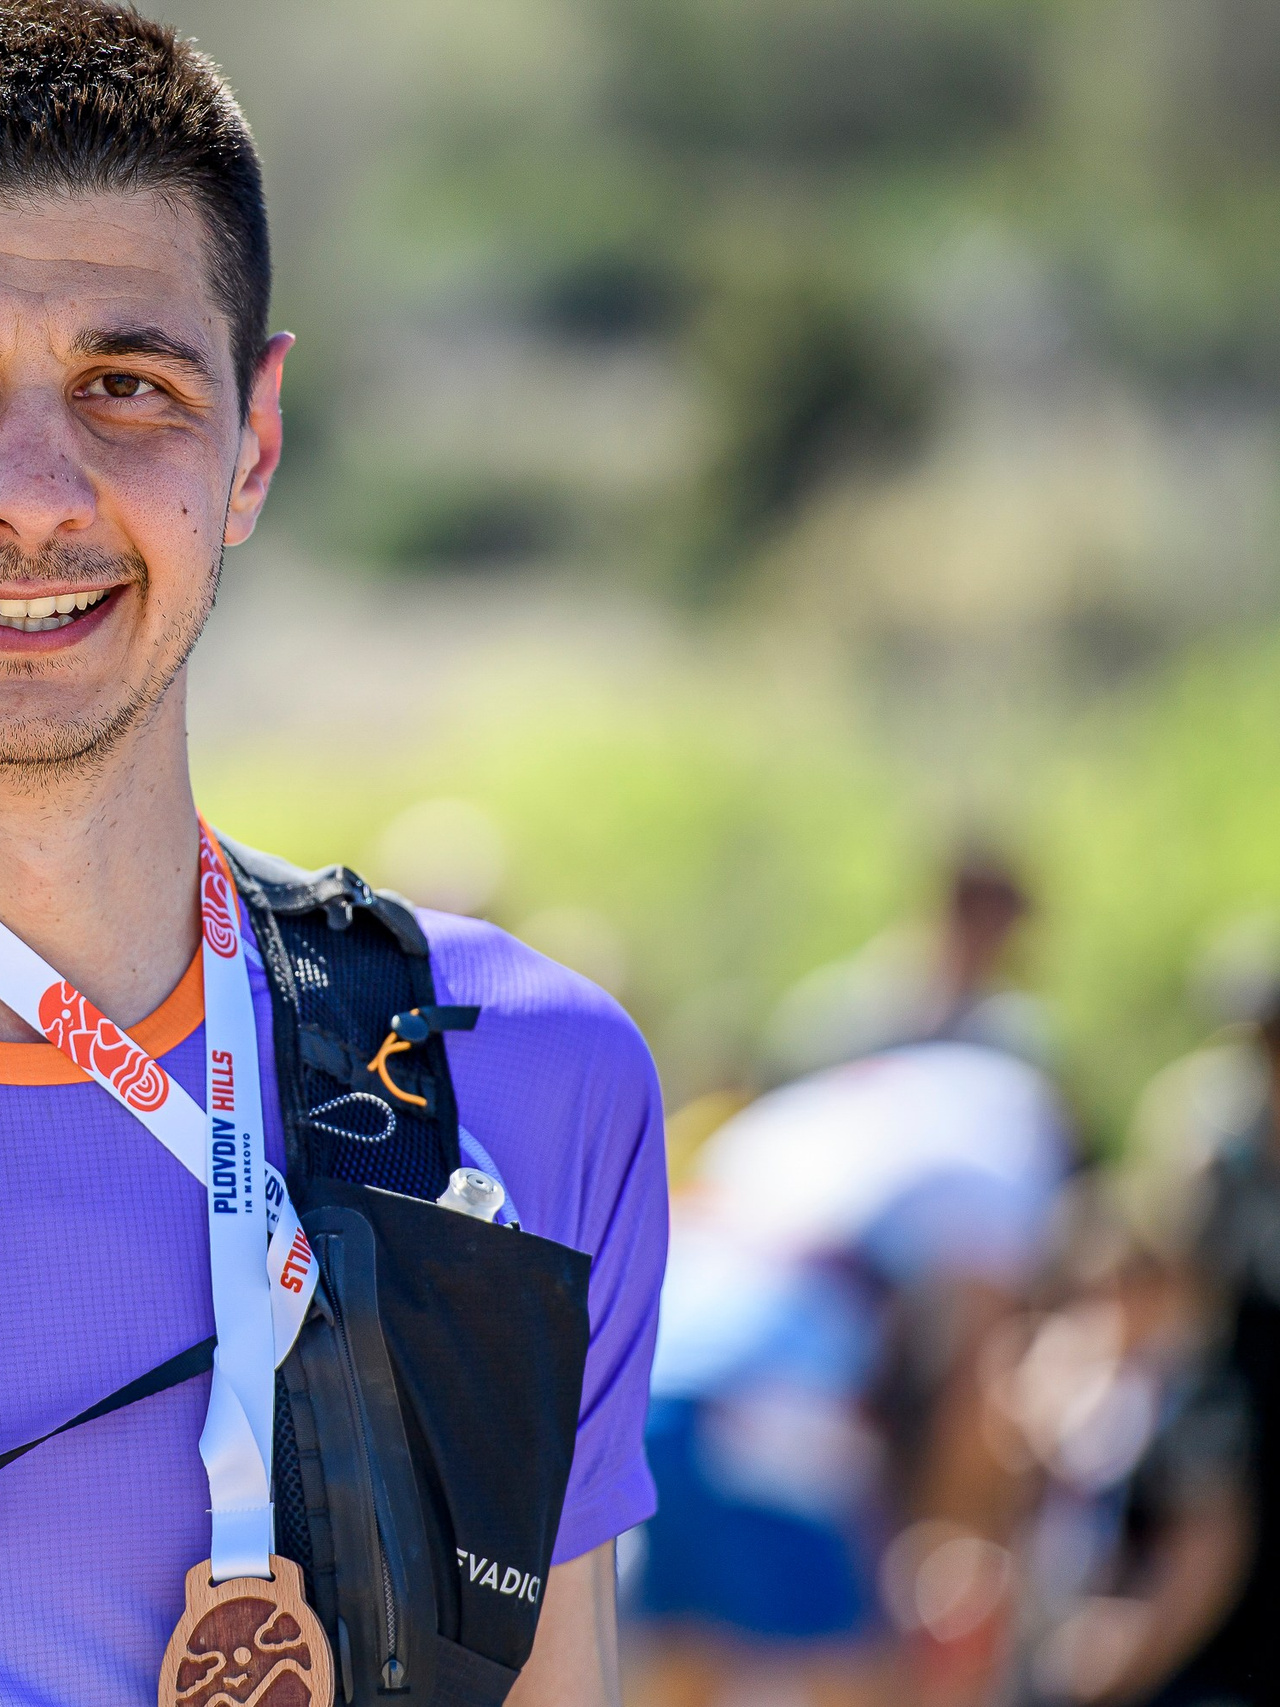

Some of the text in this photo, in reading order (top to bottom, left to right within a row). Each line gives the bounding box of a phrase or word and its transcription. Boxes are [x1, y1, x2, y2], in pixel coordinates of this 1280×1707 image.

[212, 1050, 238, 1214] PLOVDIV HILLS
[242, 1132, 253, 1214] IN MARKOVO
